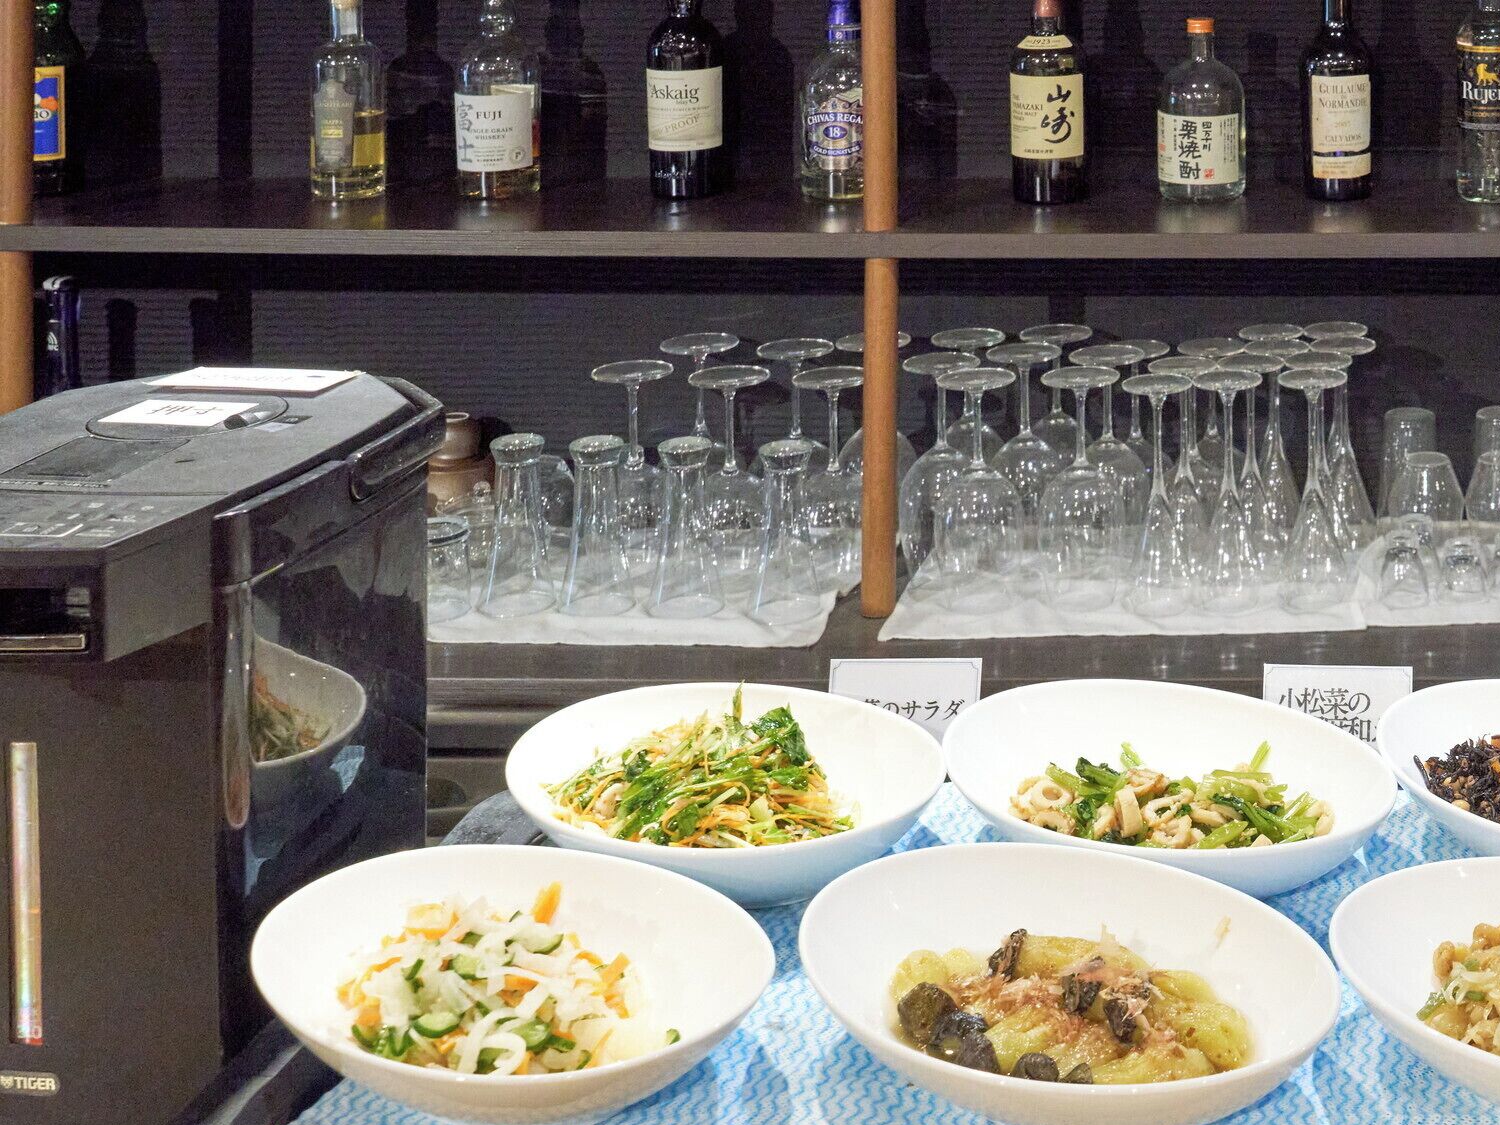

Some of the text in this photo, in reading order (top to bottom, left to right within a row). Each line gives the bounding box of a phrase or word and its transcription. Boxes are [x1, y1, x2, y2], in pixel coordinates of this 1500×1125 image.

[650, 84, 699, 104] Askaig
[476, 110, 502, 120] FUJI
[807, 114, 835, 125] CHIVAS
[829, 127, 840, 138] 18
[1278, 687, 1371, 715] 小松菜の
[14, 1076, 56, 1091] TIGER
